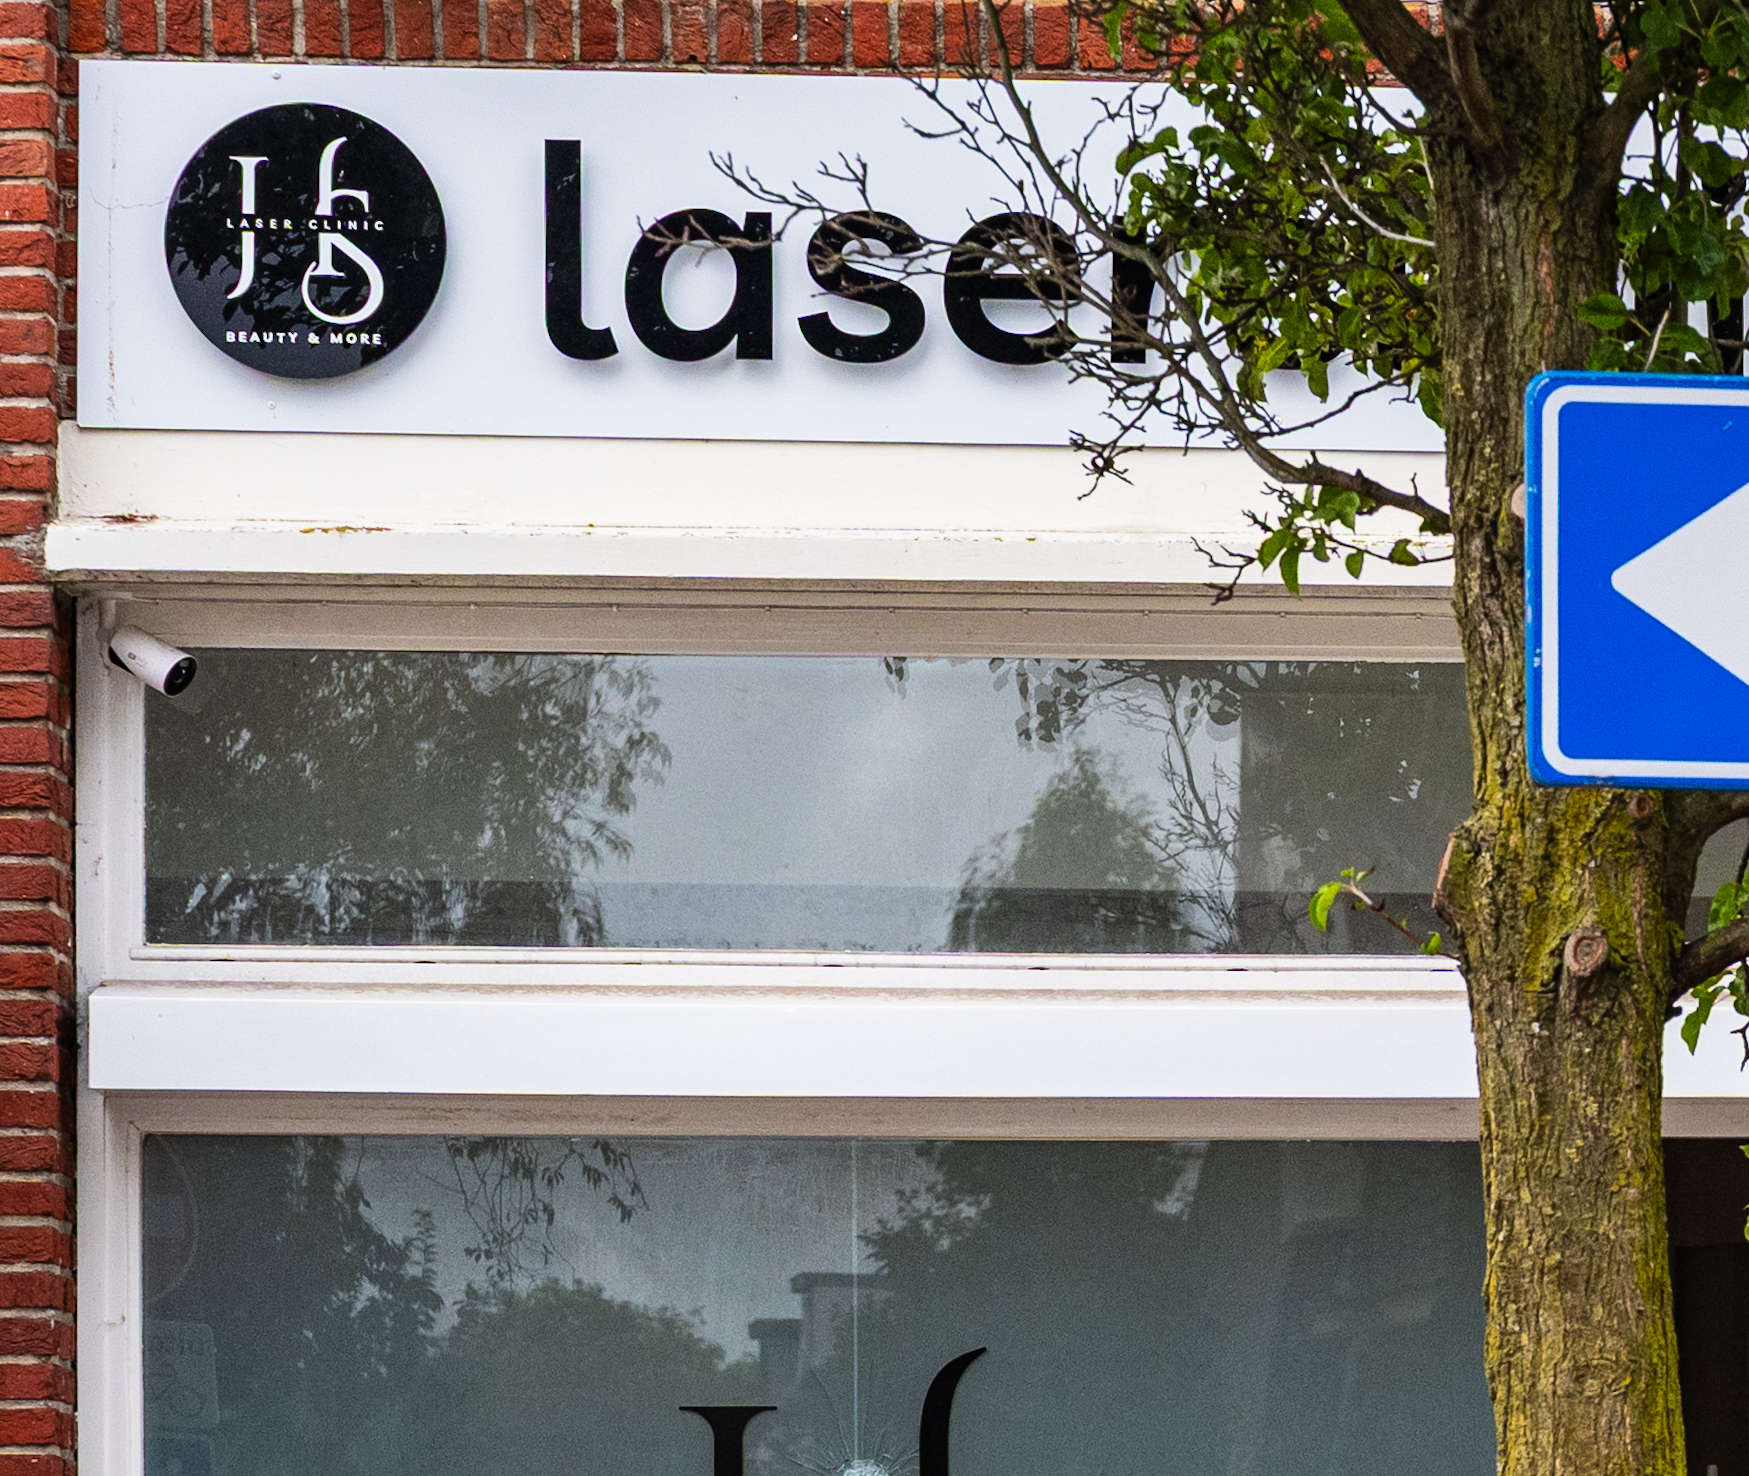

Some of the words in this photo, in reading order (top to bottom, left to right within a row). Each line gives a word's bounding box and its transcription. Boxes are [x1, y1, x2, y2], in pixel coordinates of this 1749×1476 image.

[226, 217, 293, 230] LASER
[308, 219, 385, 231] CLINIC
[225, 331, 298, 344] BEAUTY
[307, 332, 320, 344] &
[329, 333, 383, 345] MORE
